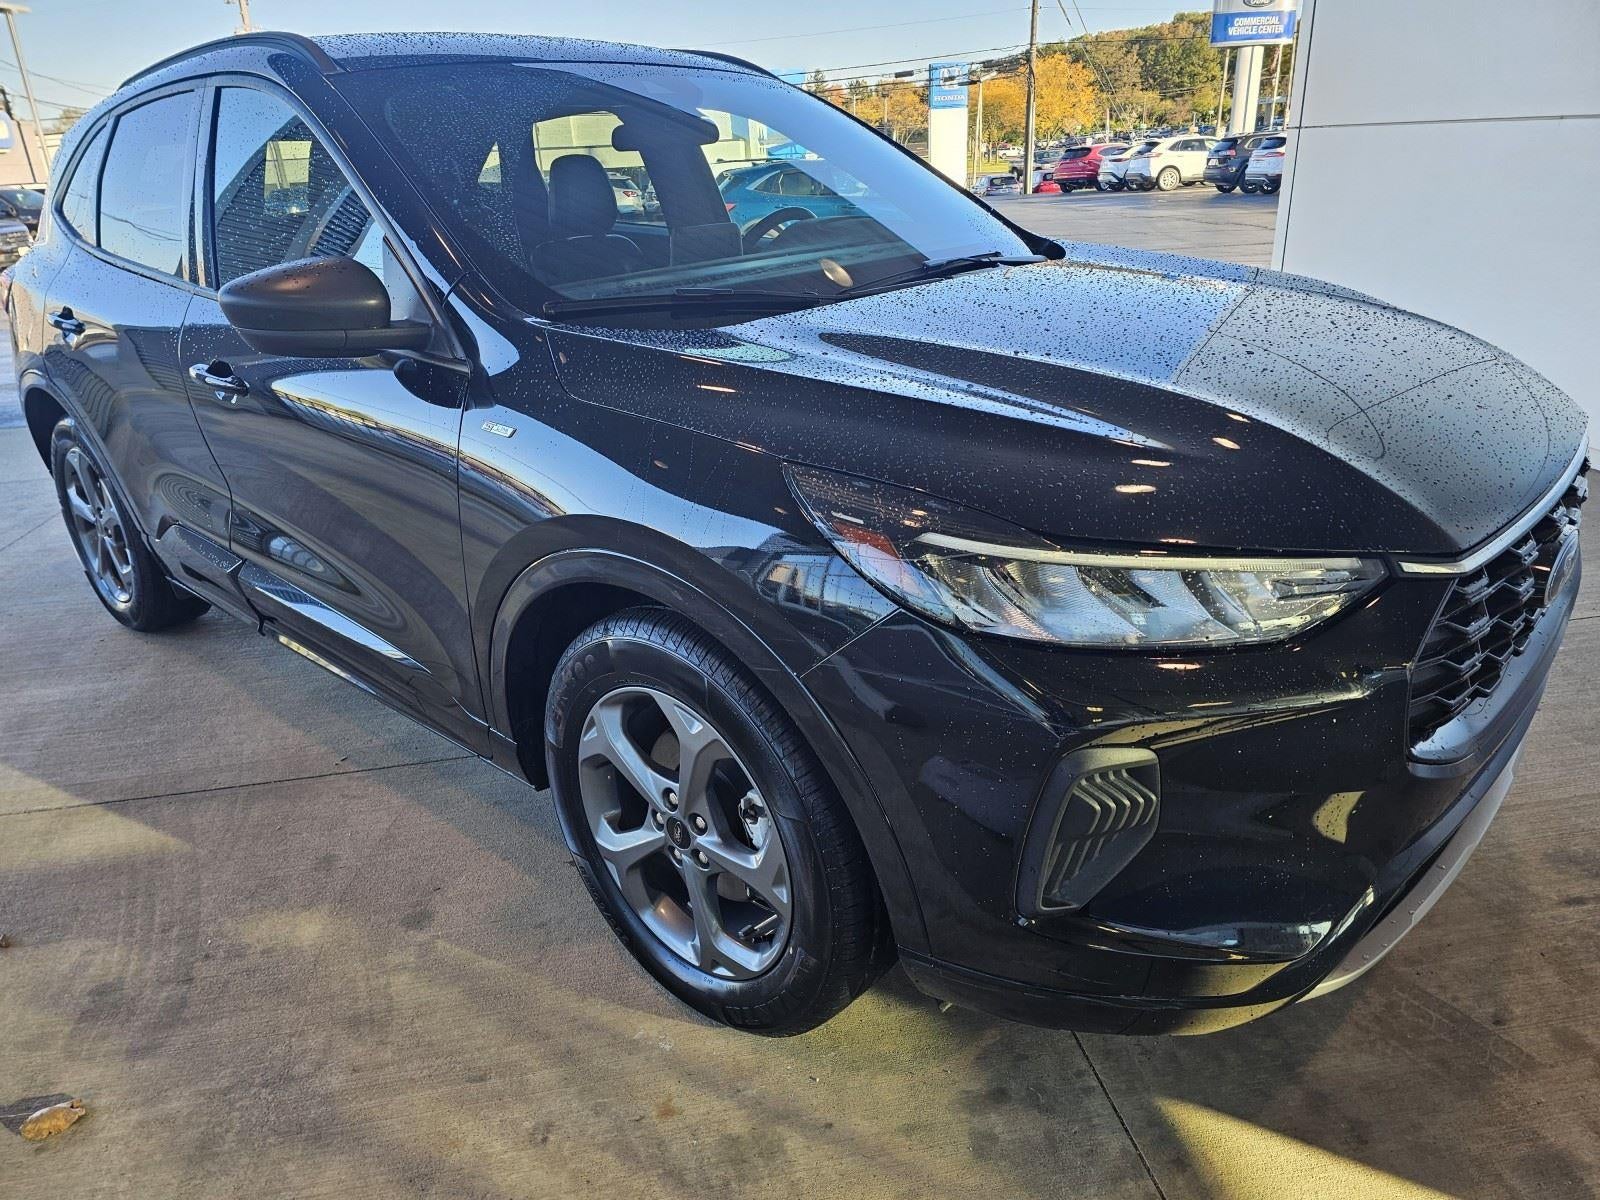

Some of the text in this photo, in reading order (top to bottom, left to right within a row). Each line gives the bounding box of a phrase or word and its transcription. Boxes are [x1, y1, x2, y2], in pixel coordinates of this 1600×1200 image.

[1234, 16, 1280, 26] COMMERCIAL
[1228, 24, 1284, 35] VEHICLE CENTER
[934, 94, 966, 102] HONDA
